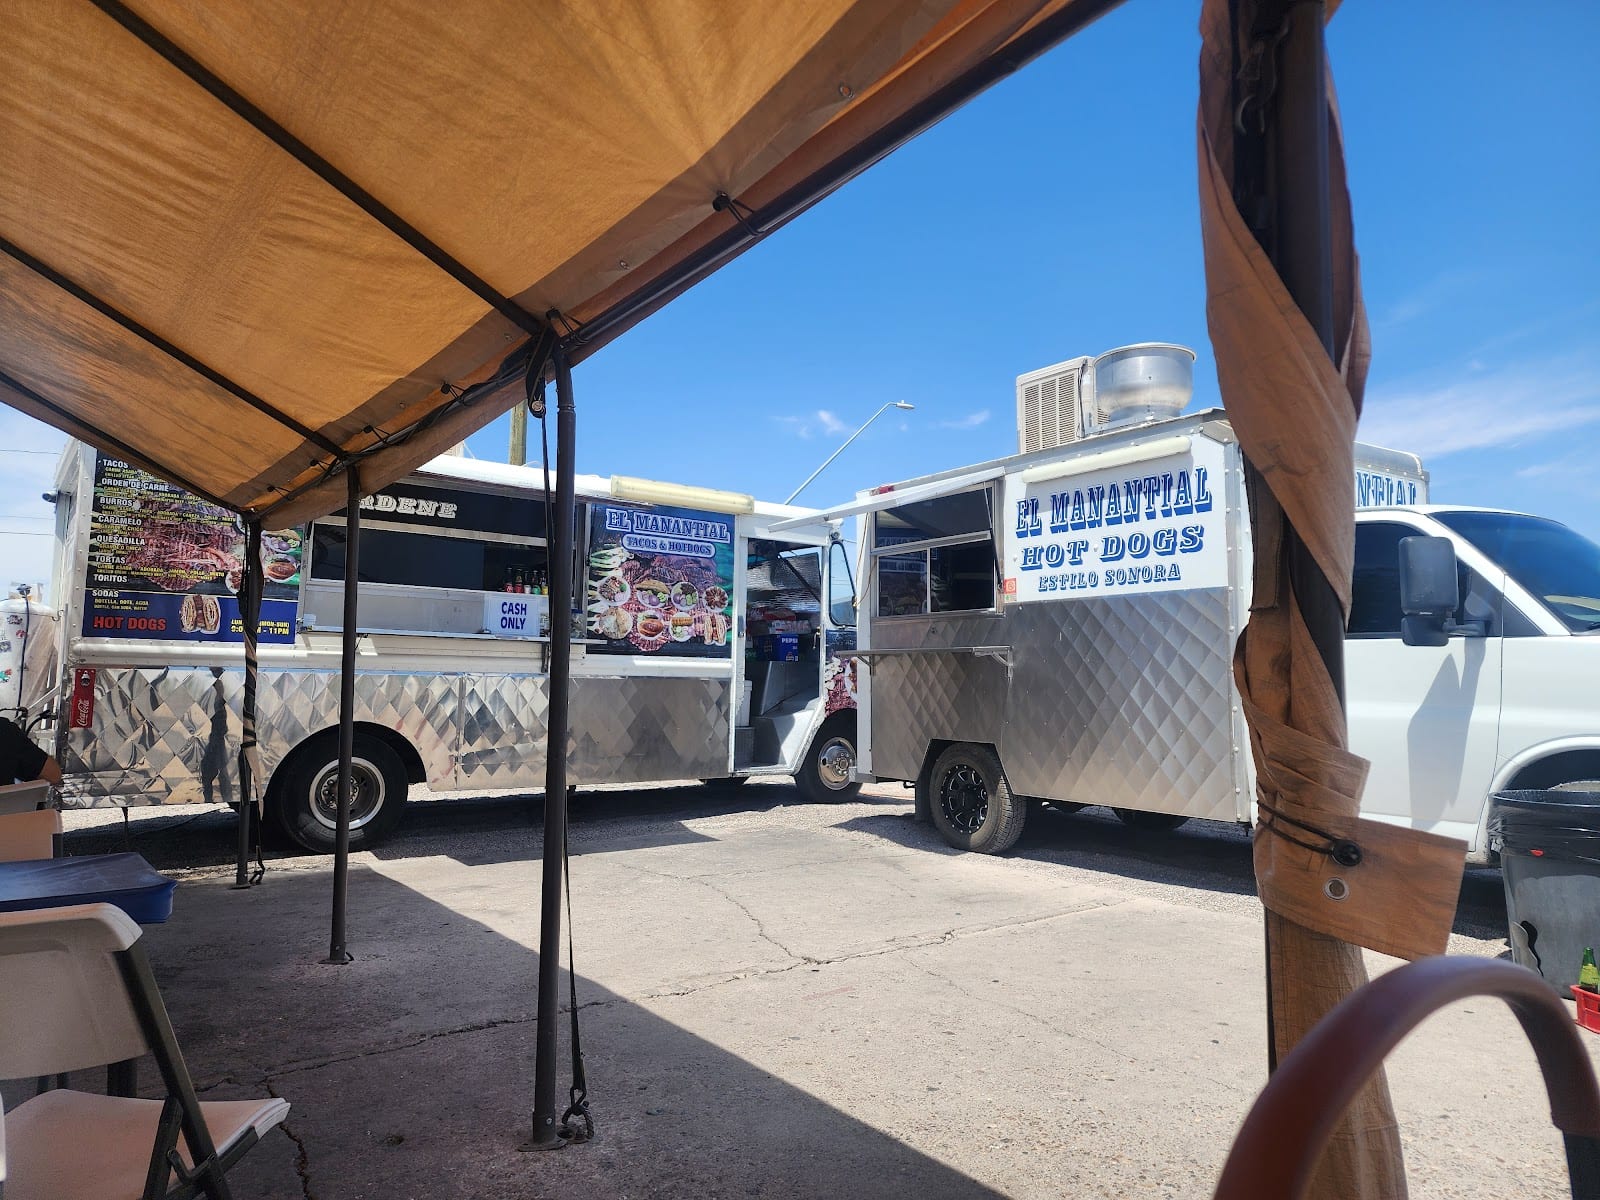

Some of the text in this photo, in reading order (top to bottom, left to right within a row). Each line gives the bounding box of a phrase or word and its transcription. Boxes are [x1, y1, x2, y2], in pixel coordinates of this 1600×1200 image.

[103, 459, 129, 469] TACOS
[102, 478, 129, 488] ORDEN
[131, 480, 142, 489] DE
[143, 482, 170, 492] CARNE
[99, 497, 133, 507] BURROS
[1016, 466, 1212, 538] EL MANANTIAL
[98, 515, 142, 526] CARAMELO
[606, 509, 730, 543] EL MANANTIAL
[97, 534, 146, 546] QUESADILLA
[627, 536, 657, 549] TACOS
[668, 542, 711, 556] HOTDOGS
[1020, 524, 1204, 571] HOT DOGS
[96, 555, 126, 564] TORTAS
[94, 573, 128, 583] TORITOS
[1038, 563, 1181, 592] ESTILO SONORA
[501, 602, 527, 615] CASH
[94, 616, 166, 630] HOT DOGS
[500, 616, 526, 630] ONLY
[269, 627, 290, 635] 11PM
